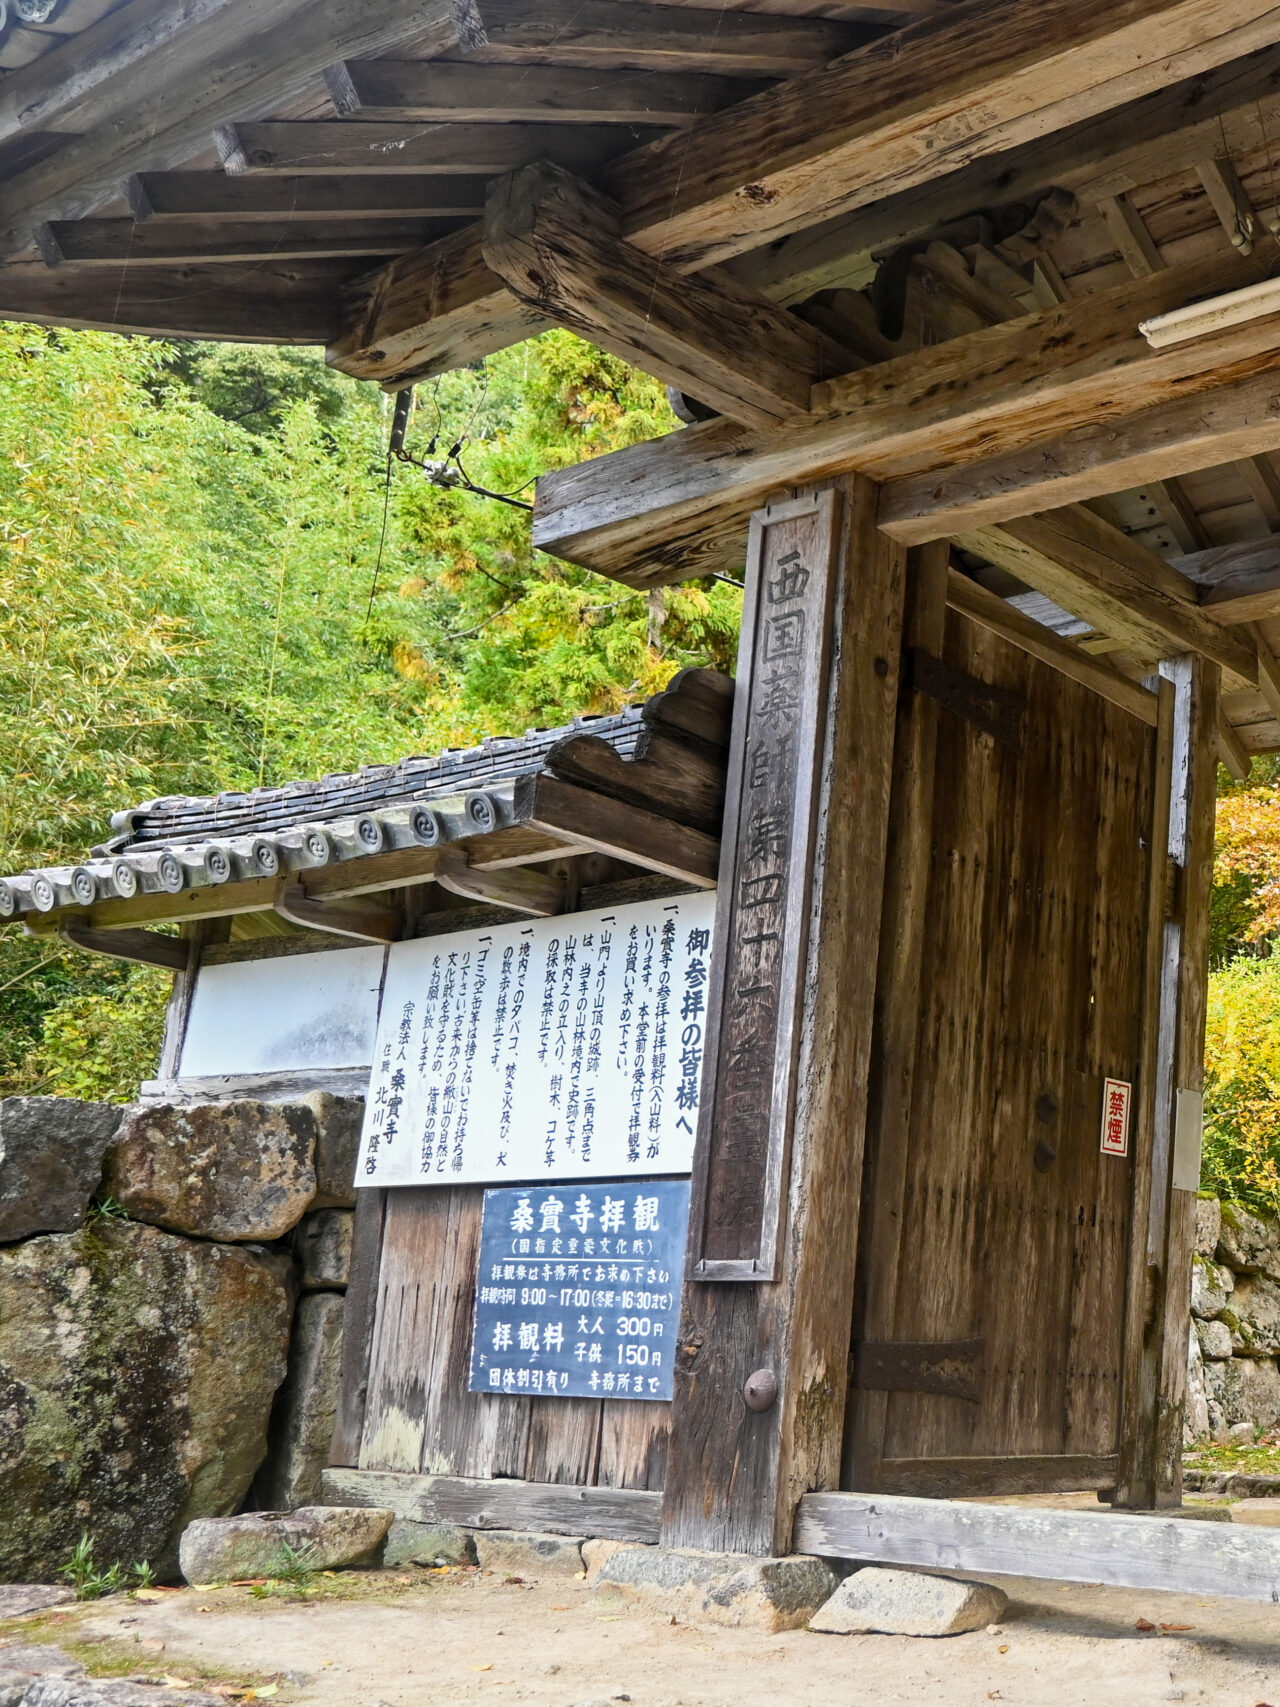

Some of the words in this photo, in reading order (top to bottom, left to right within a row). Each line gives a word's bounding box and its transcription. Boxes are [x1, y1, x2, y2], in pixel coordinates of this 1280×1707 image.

[396, 1001, 415, 1061] 宗教法人
[674, 927, 710, 1135] 御参拝の皆様へ
[1107, 1090, 1125, 1144] 禁煙
[510, 1194, 660, 1234] 桑實寺拝観
[491, 1264, 669, 1284] 拝観券は寺務所でお求め下さい
[480, 1287, 516, 1305] 拝観時間
[492, 1322, 564, 1352] 拝観料
[577, 1315, 605, 1334] 大人
[616, 1317, 663, 1337] 300円
[574, 1343, 602, 1363] 子供
[617, 1345, 662, 1367] 150円
[489, 1368, 569, 1393] 団体割引有り
[588, 1371, 660, 1392] 寺務所まで
